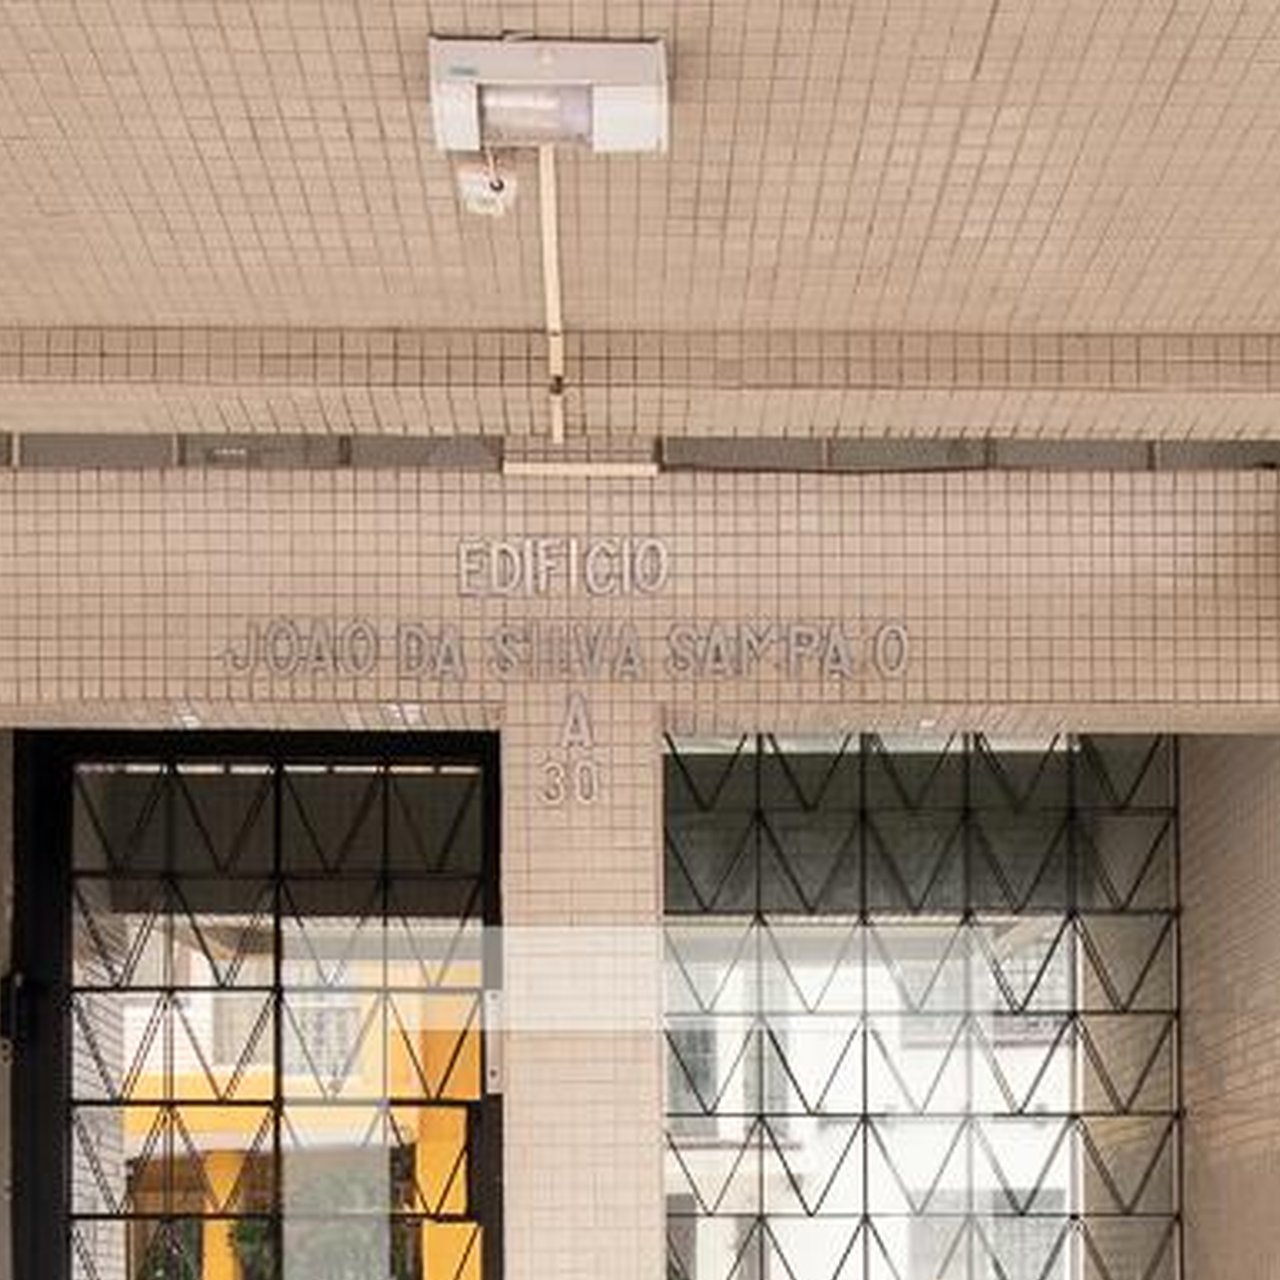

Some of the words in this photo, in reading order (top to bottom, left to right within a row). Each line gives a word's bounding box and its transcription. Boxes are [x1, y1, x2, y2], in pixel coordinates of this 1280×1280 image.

[460, 537, 669, 594] EDIFICIO
[398, 622, 467, 680] DA
[493, 620, 643, 682] SILVA
[666, 622, 909, 680] SAMPAO
[561, 692, 594, 749] A
[538, 759, 599, 804] 30
